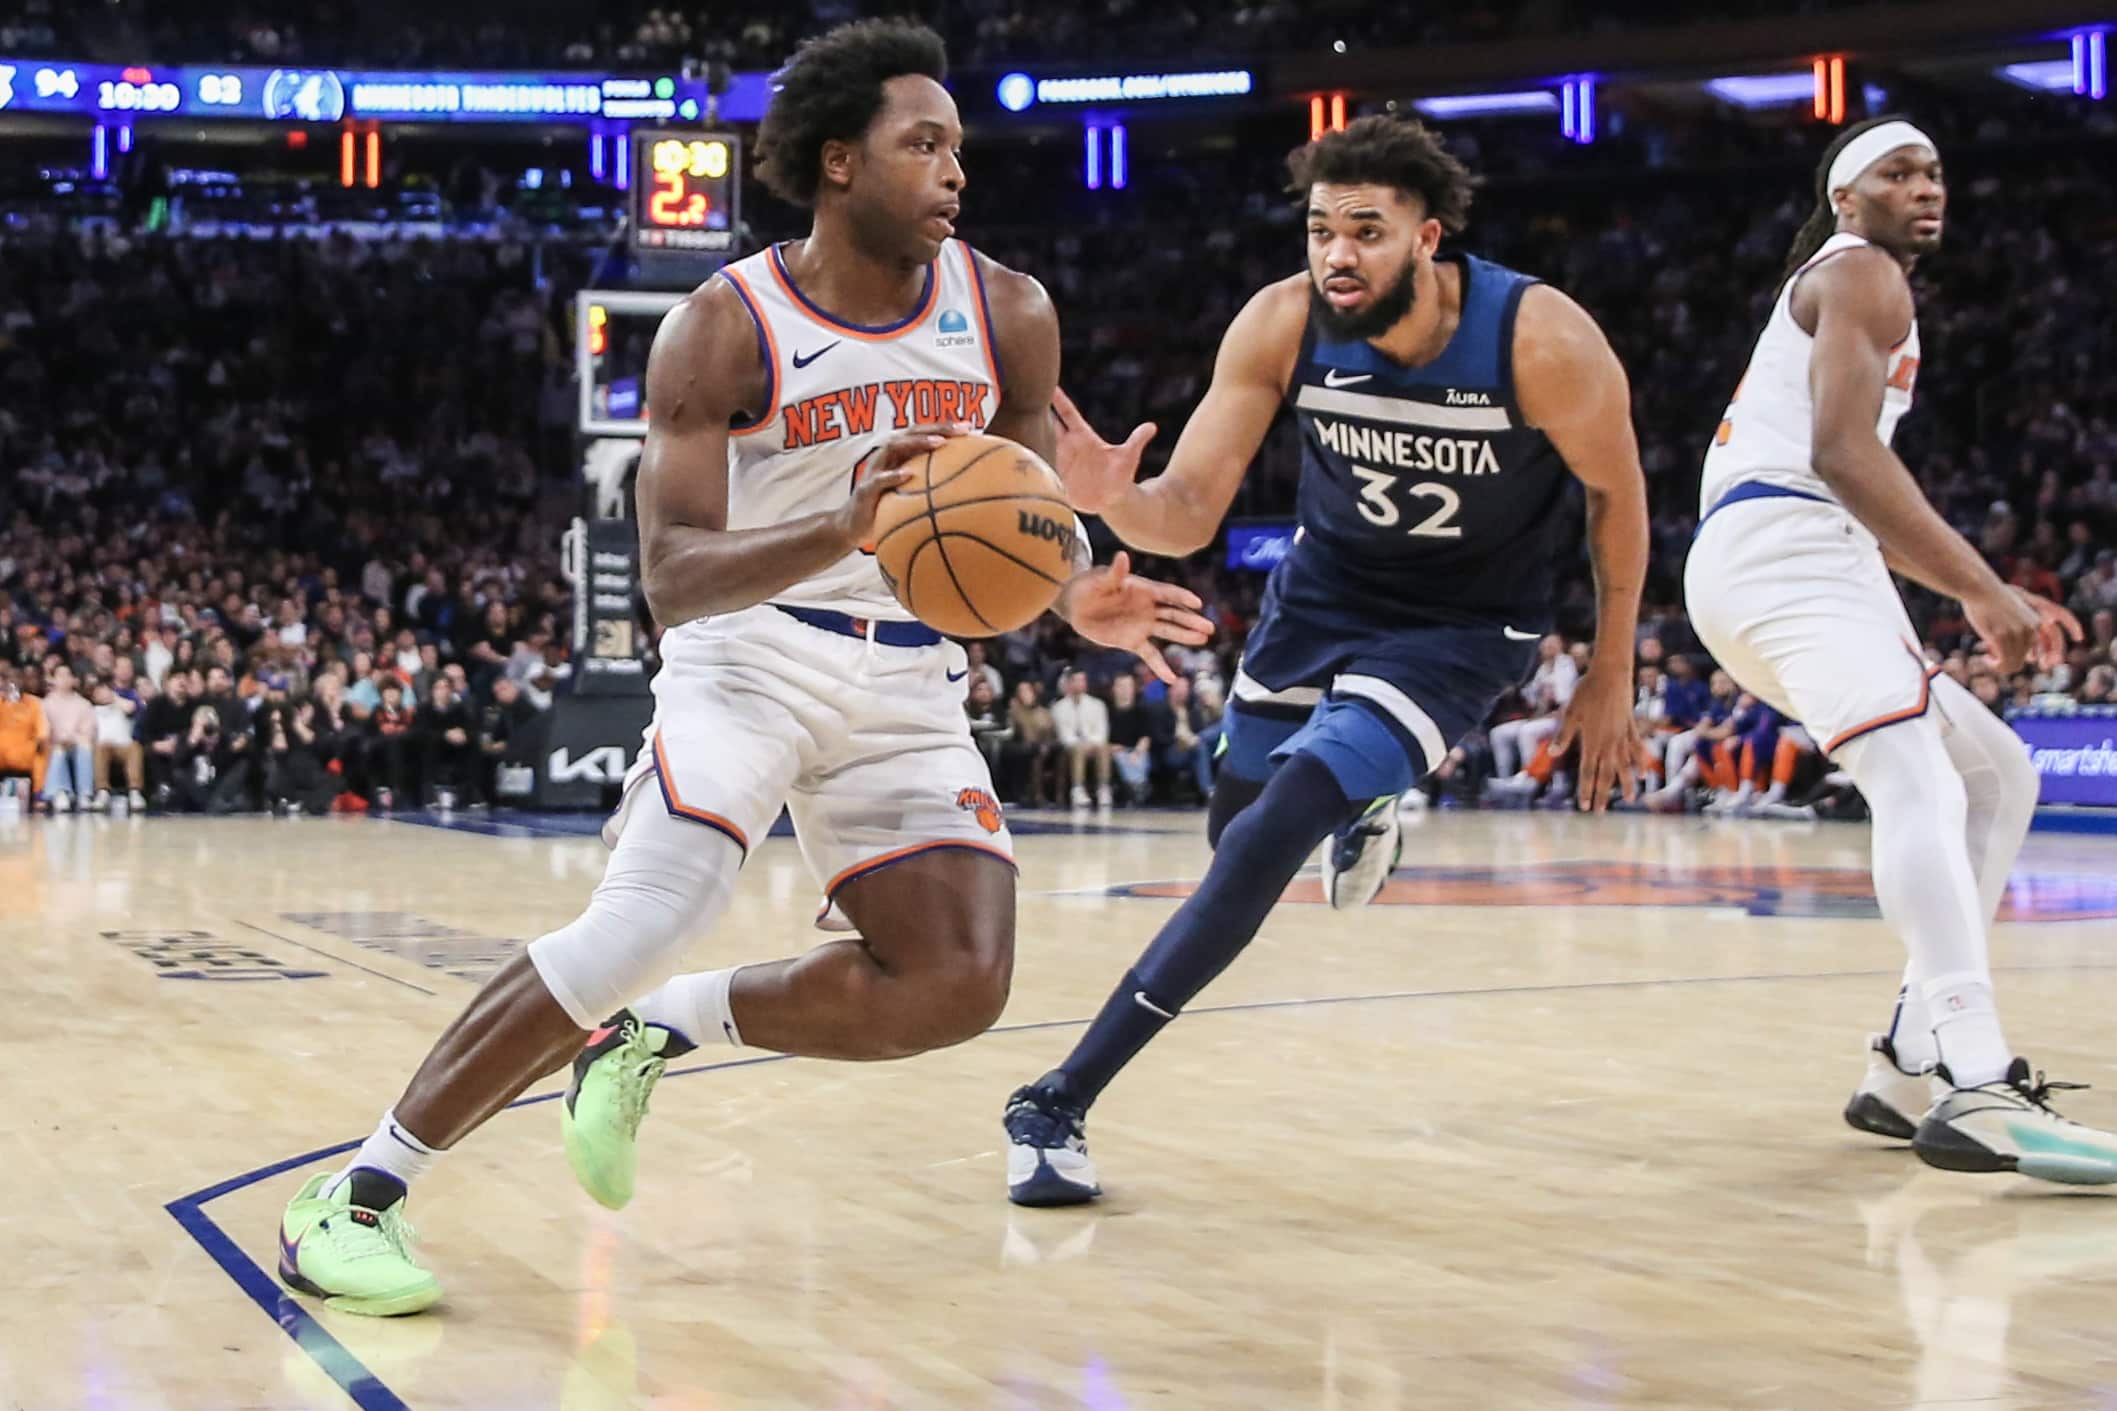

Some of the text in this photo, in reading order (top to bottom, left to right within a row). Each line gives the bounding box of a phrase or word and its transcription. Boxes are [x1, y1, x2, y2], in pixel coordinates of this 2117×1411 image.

[936, 336, 974, 347] sphere
[783, 379, 988, 449] NEW YORK
[1313, 417, 1501, 475] MINNESOTA
[1351, 464, 1462, 537] 32
